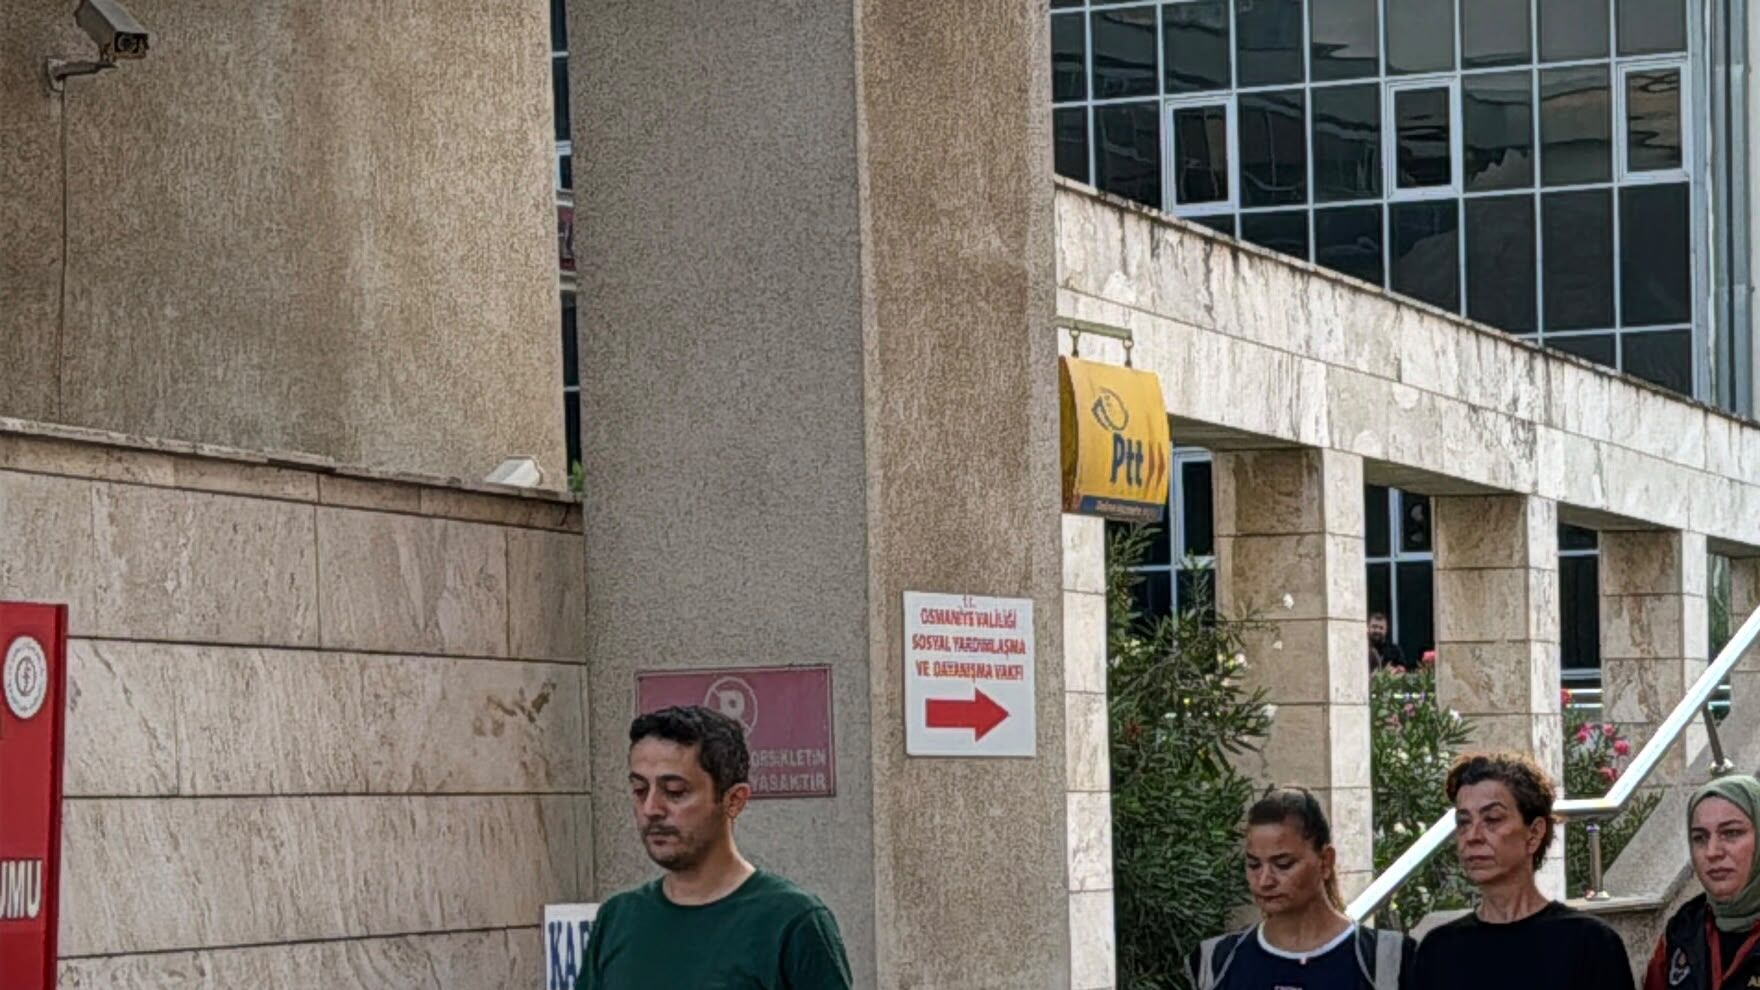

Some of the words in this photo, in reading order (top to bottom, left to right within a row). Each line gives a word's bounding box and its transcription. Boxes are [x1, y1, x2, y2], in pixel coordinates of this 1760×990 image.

[1110, 431, 1144, 487] Ptt
[911, 632, 951, 652] SOSYAL
[915, 660, 930, 677] VE
[933, 660, 993, 683] DAYANIŞMA
